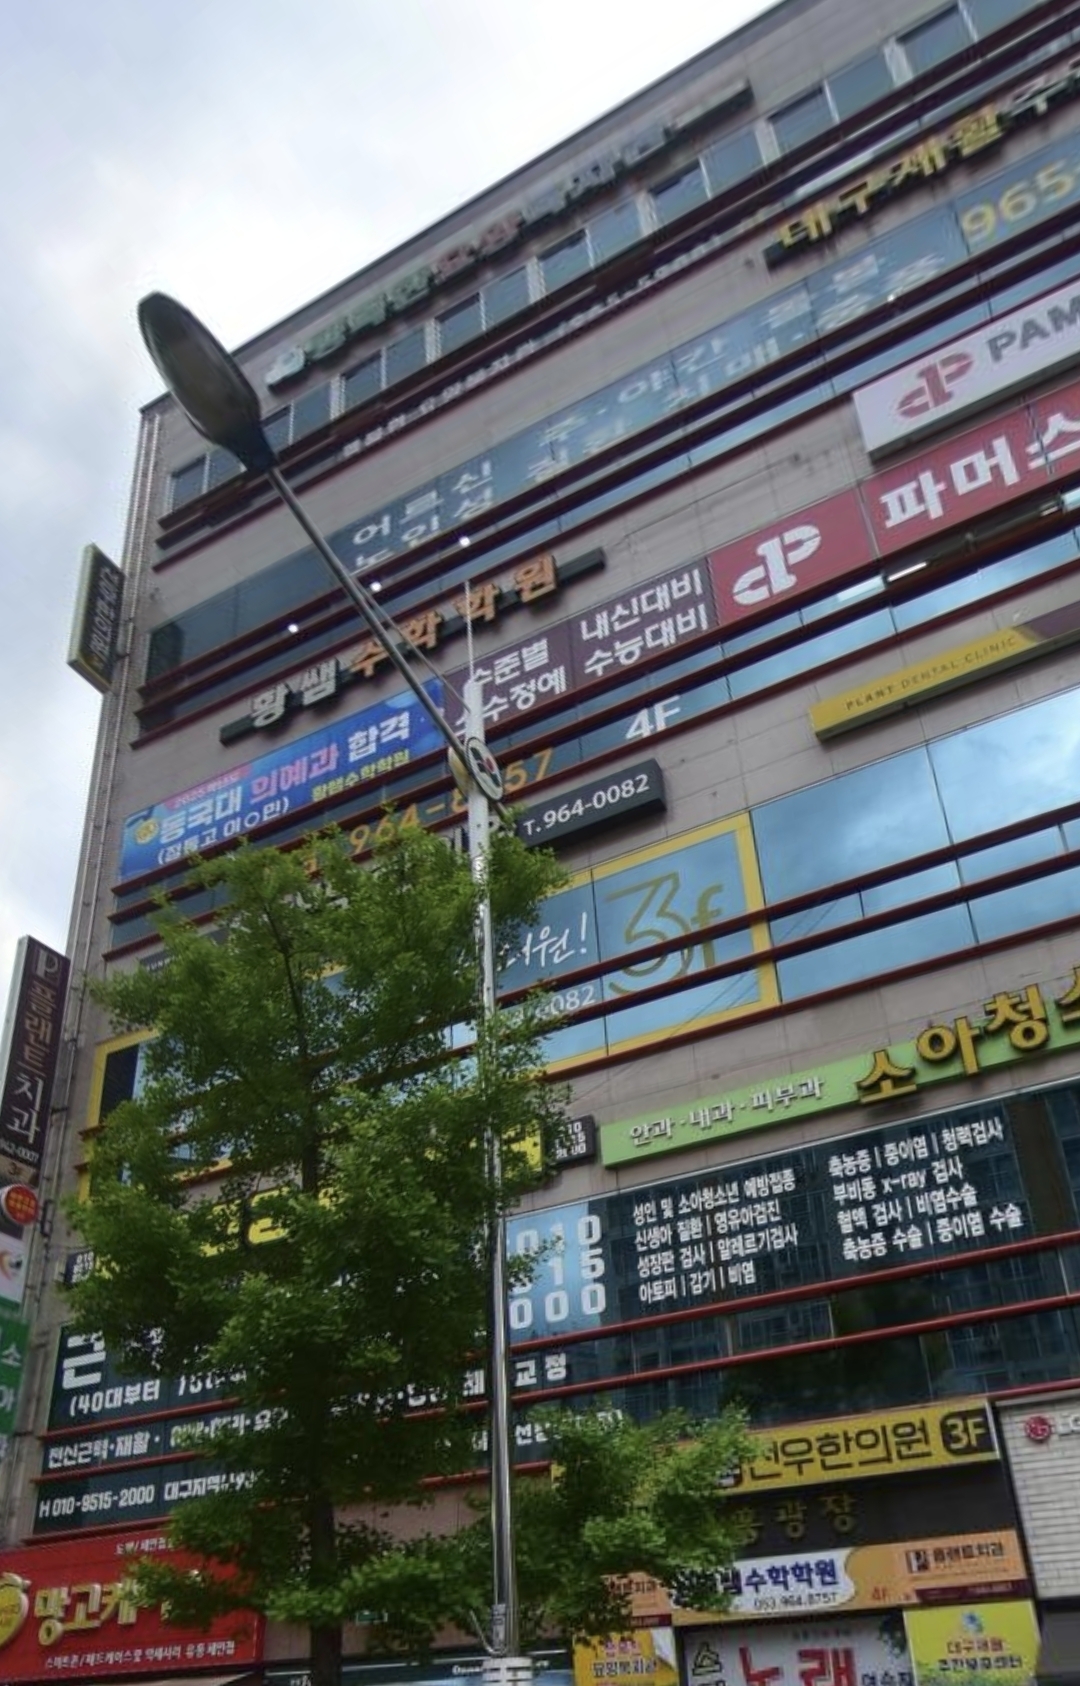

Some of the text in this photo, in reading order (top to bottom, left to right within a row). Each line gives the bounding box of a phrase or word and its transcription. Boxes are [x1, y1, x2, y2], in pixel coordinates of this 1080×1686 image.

[880, 413, 1080, 529] 파머스
[351, 460, 493, 547] 어르신
[579, 567, 703, 652] 내신대비
[583, 603, 708, 677] 수능대비
[901, 661, 959, 693] DENTAL
[965, 636, 1016, 665] CLINIC
[624, 695, 682, 742] 4F
[160, 711, 411, 843] 동국대 의예과 합격
[828, 1118, 1003, 1179] 축농증 중이염 청력검사
[632, 1168, 797, 1227] 성인 및 소아청소년 예방접종
[832, 1175, 877, 1204] 부비동
[932, 1156, 964, 1184] 검사
[872, 1198, 902, 1224] 검사
[917, 1182, 978, 1215] 비염수술
[635, 1198, 782, 1252] 신생아 질환 영유아검진
[637, 1223, 799, 1279] 성장판 검사 알레르기검사
[842, 1202, 1023, 1262] 축농증 수술 중이염 수술
[639, 1260, 756, 1305] 아토피 감기 비염
[69, 1379, 160, 1417] (40대부터
[949, 1416, 990, 1452] 3F
